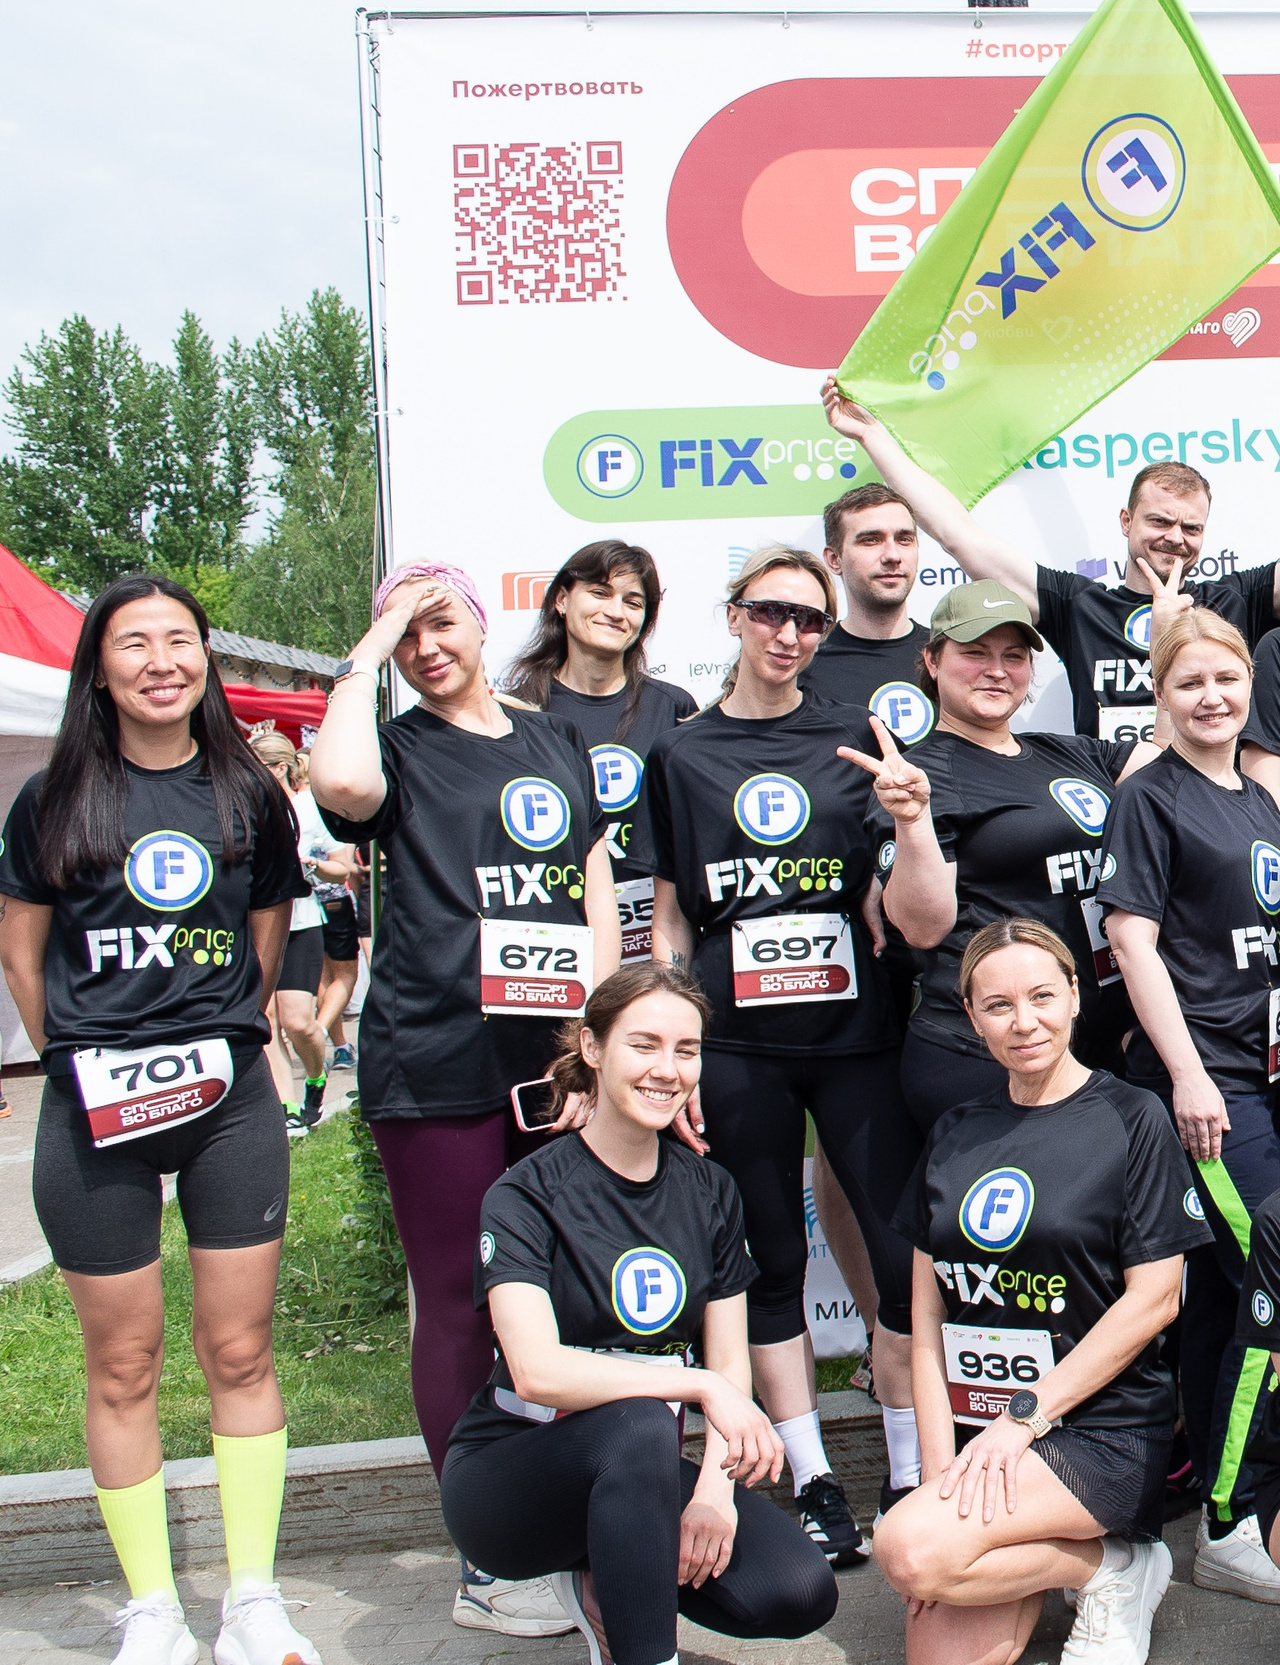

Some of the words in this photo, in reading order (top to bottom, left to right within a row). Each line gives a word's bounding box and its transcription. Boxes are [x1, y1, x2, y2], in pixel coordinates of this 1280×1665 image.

[453, 80, 643, 101] Пожертвовать
[499, 944, 578, 973] 672
[752, 935, 838, 963] 697
[504, 981, 568, 994] СПОРТ
[760, 971, 829, 983] СПОРТ
[760, 983, 782, 993] ВО
[784, 979, 830, 991] БЛАГО
[504, 991, 525, 1001] ВО
[526, 992, 568, 1004] БЛАГО
[109, 1048, 204, 1092] 701
[119, 1088, 202, 1117] СПОРТ
[121, 1111, 147, 1127] ВО
[149, 1097, 203, 1120] БЛАГО
[958, 1349, 1041, 1383] 936
[969, 1401, 986, 1412] ВО
